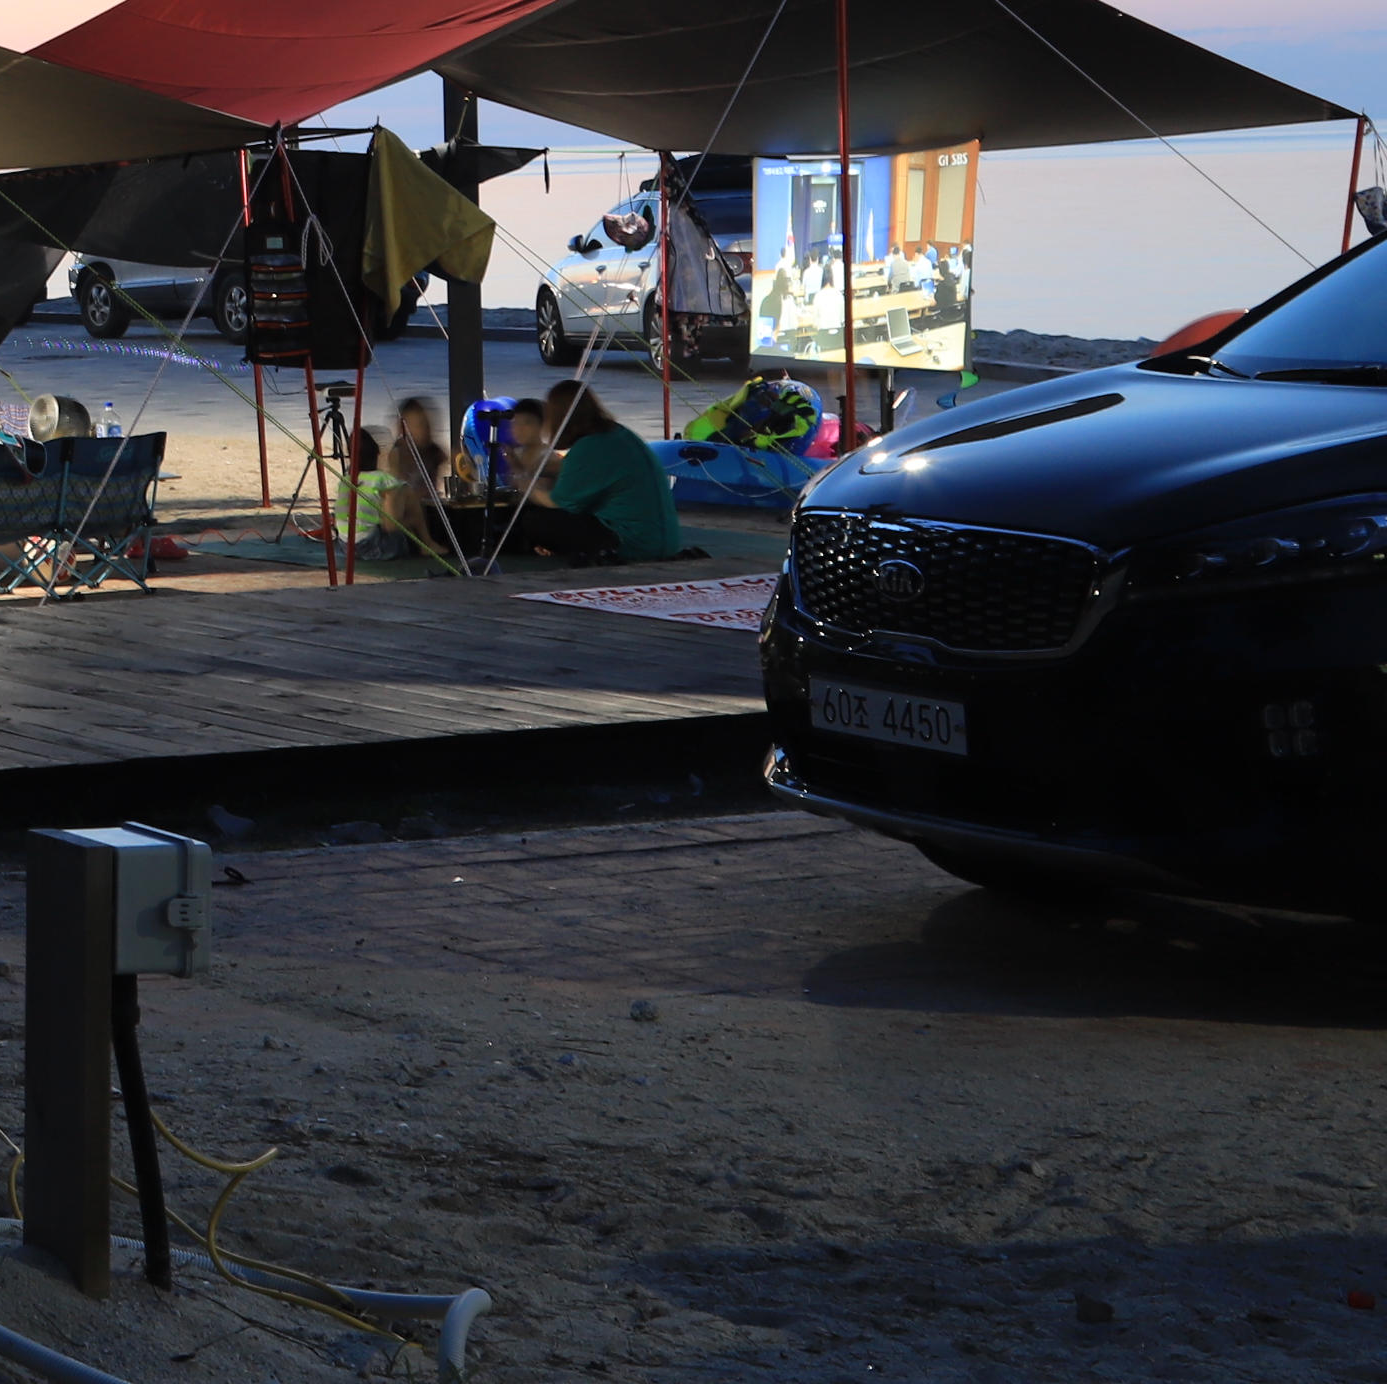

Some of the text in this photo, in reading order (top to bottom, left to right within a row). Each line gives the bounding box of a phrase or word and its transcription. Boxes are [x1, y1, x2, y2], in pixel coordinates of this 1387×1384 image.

[951, 152, 969, 166] SBS
[879, 568, 914, 593] KIA
[823, 686, 951, 745] 60조 4450
